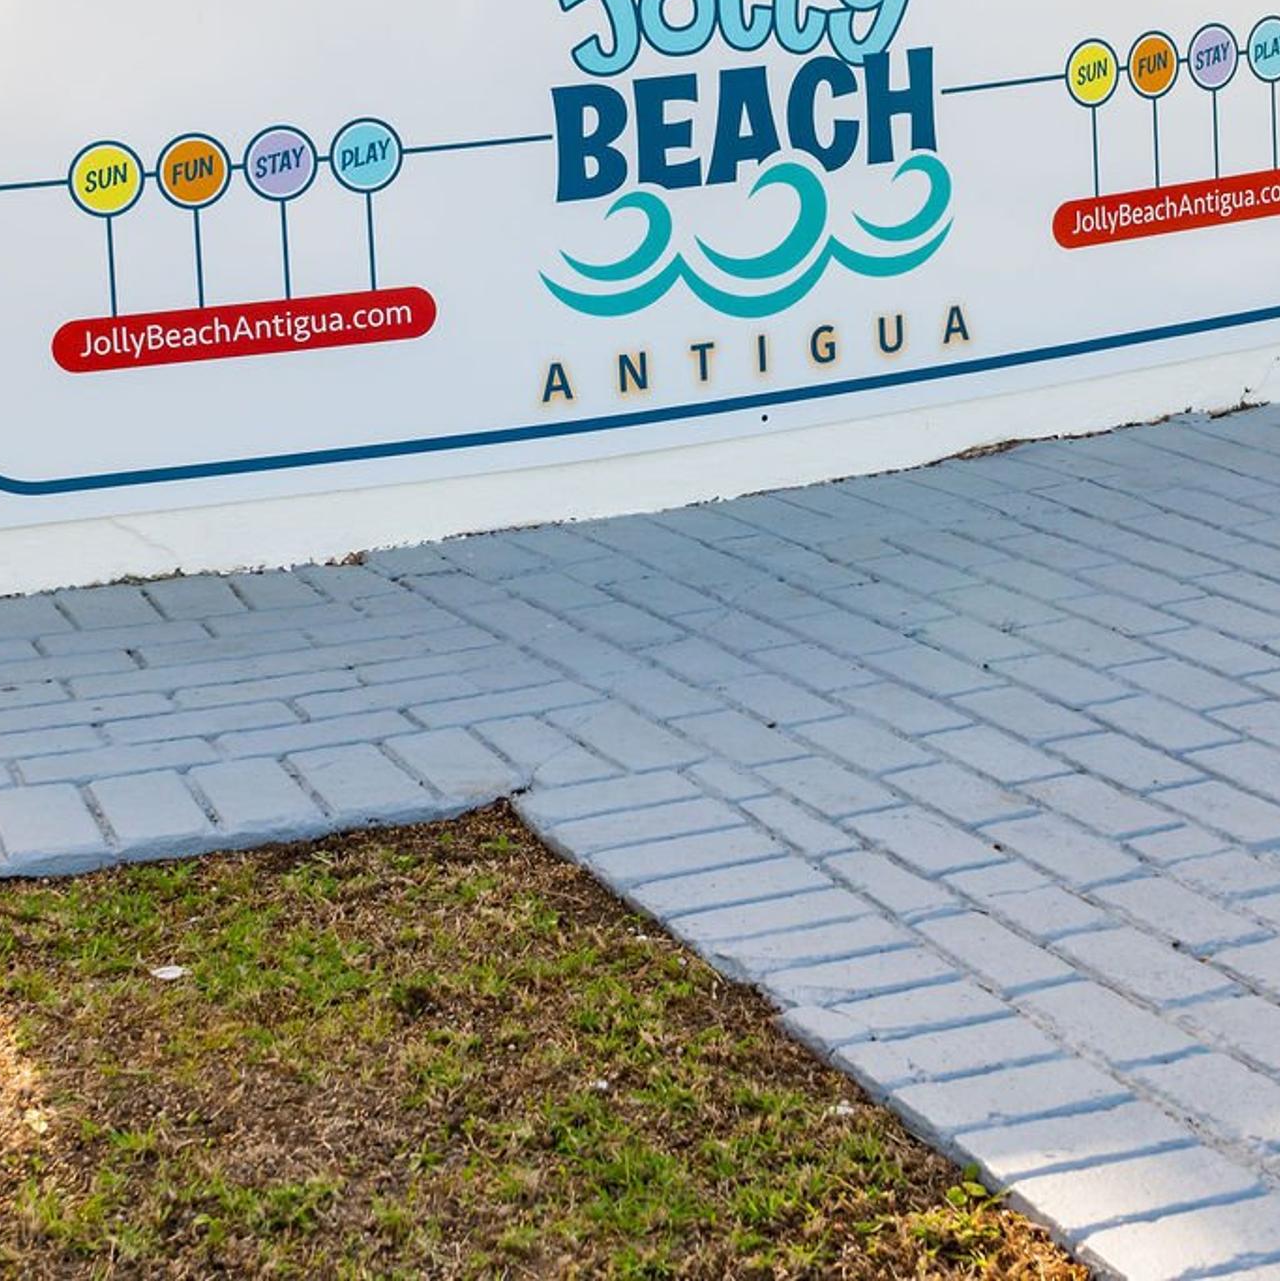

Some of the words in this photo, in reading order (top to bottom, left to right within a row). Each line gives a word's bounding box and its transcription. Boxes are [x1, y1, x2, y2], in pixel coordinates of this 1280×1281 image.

[1077, 58, 1107, 86] SUN
[1138, 50, 1168, 78] FUN
[1196, 42, 1230, 70] STAY
[551, 46, 936, 203] BEACH
[84, 163, 128, 193] SUN
[172, 155, 214, 186] FUN
[255, 145, 305, 179] STAY
[341, 137, 391, 172] PLAY
[80, 302, 413, 359] JollyBeachAntigua.com
[542, 305, 970, 402] ANTIGUA
